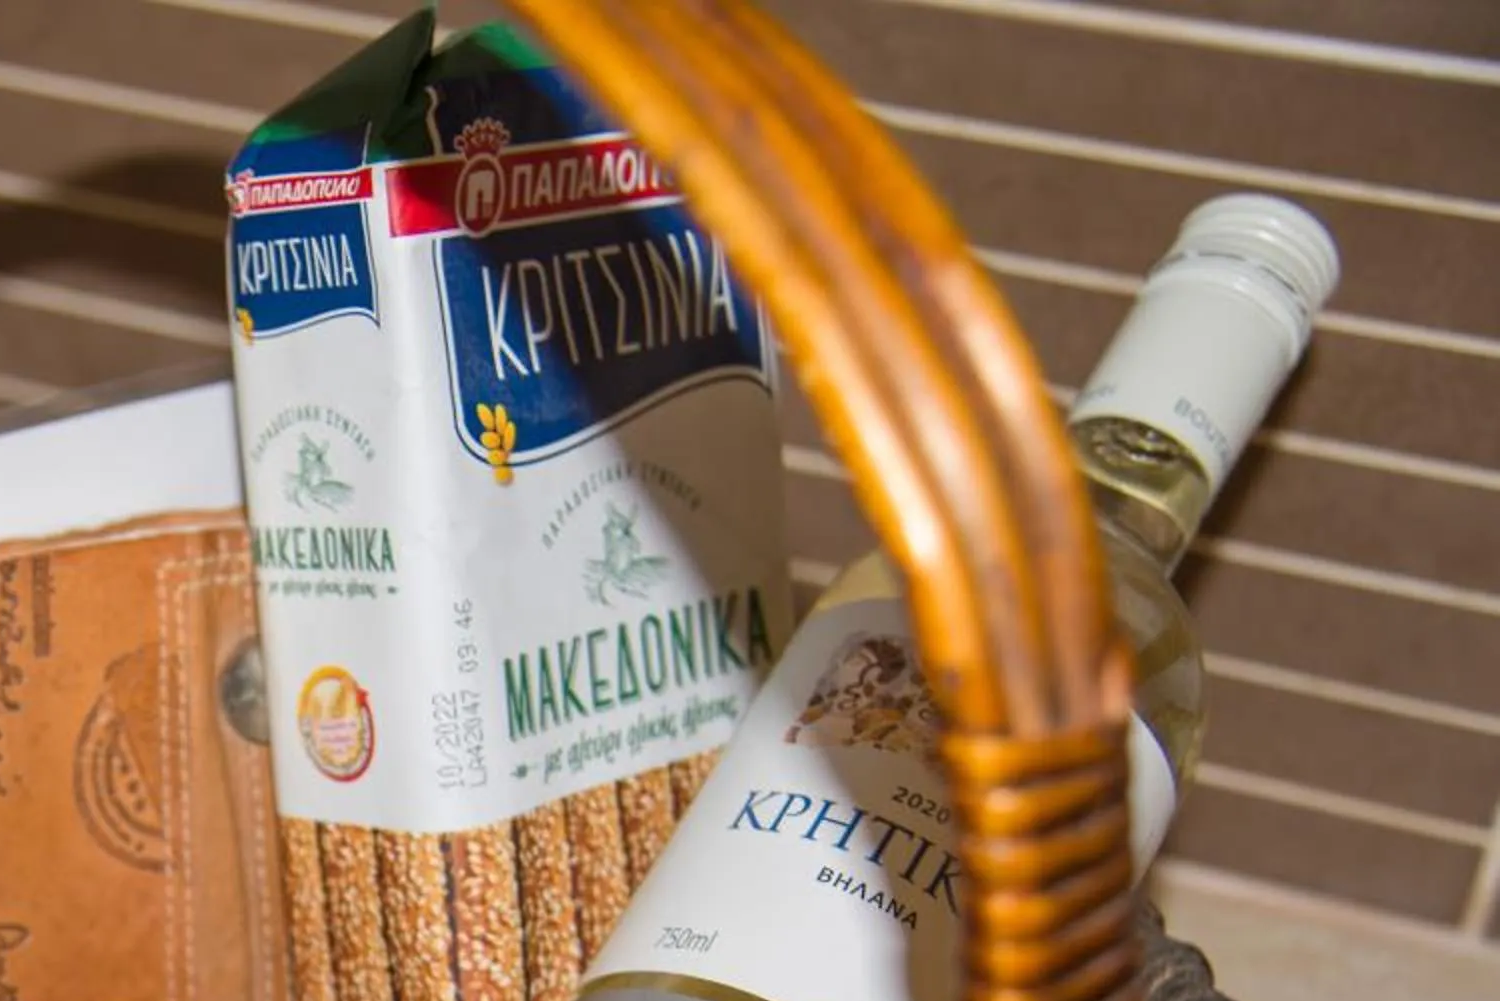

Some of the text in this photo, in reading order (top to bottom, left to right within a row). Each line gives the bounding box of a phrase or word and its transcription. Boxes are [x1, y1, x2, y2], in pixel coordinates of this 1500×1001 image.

[510, 148, 673, 210] ΠΑΠΑΔΟΠ
[237, 233, 359, 295] ΚΡΙΤΣΙΝΙΑ
[481, 228, 740, 381] ΚΡΙΤΣΙΝΙΑ
[504, 586, 773, 742] ΜΑΚΕΔΟΝΙΚΑ
[892, 784, 952, 826] 2020
[728, 788, 963, 917] ΚΡΗΤΙΚ
[653, 926, 719, 954] 750ml
